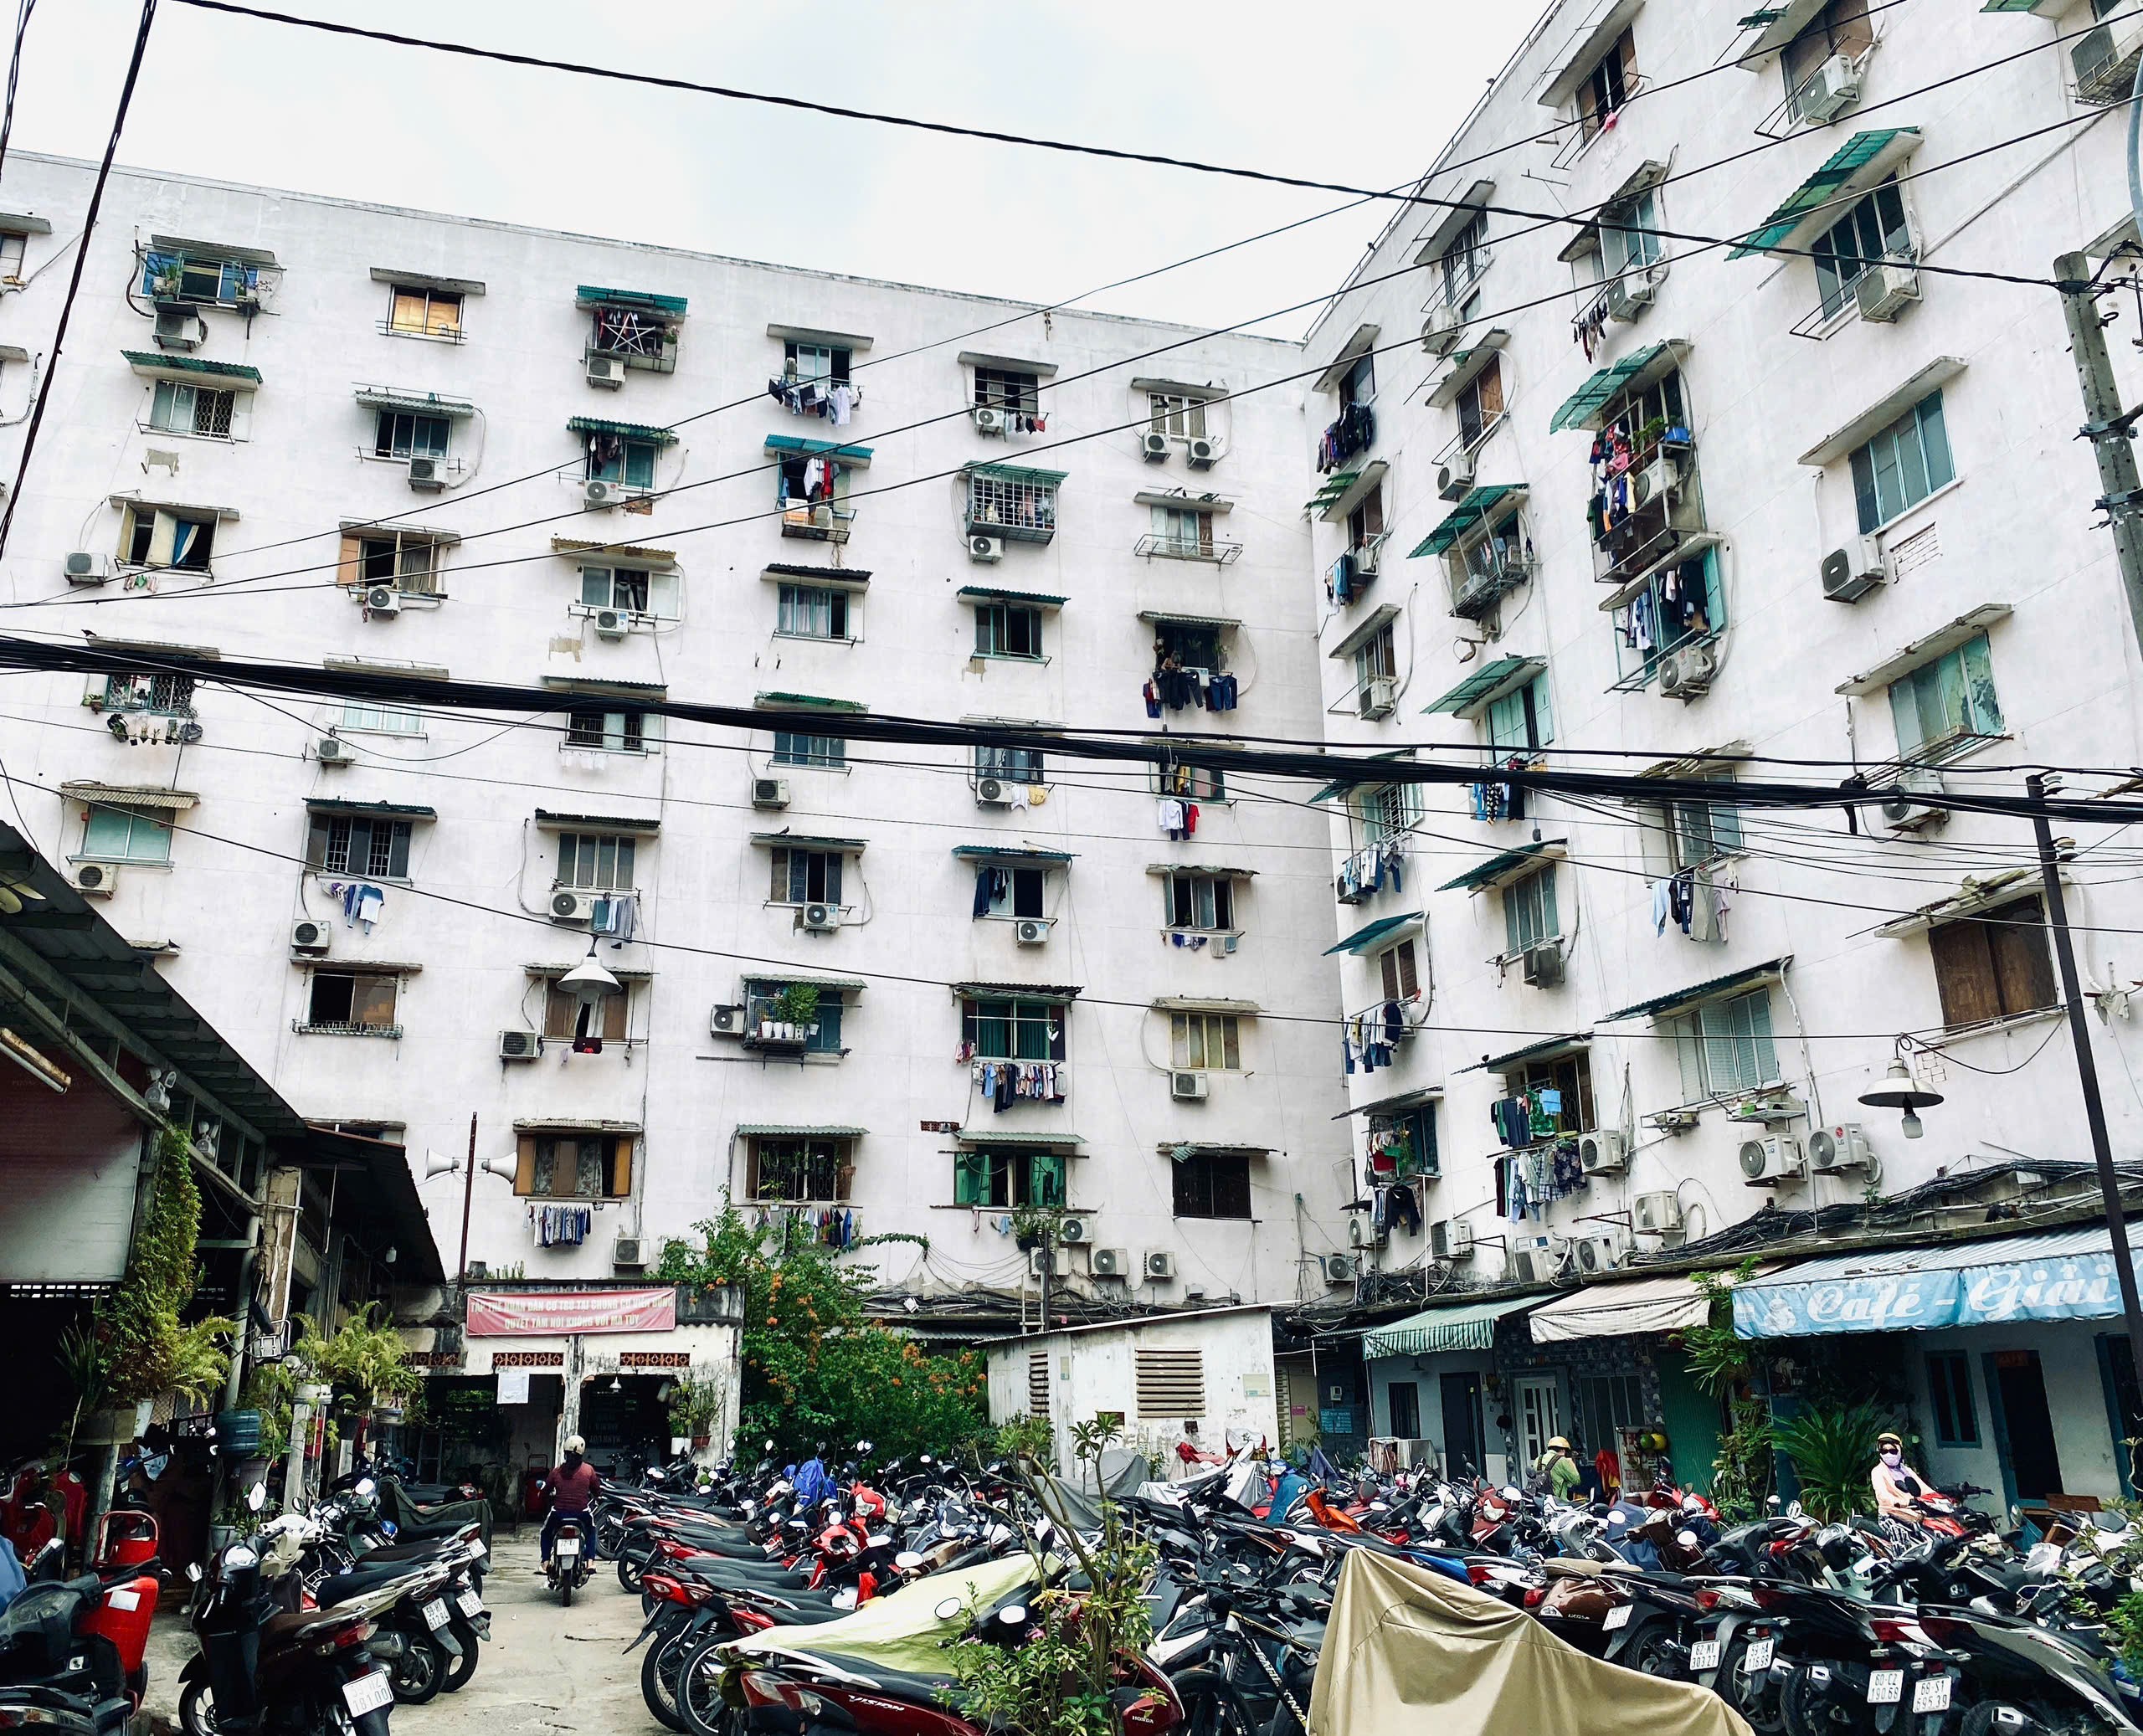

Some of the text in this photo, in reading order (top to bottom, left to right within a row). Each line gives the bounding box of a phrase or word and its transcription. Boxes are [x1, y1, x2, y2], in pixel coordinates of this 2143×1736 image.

[1806, 1281, 1925, 1327] Café
[848, 1694, 905, 1712] VISION
[1132, 1715, 1154, 1725] HONDA
